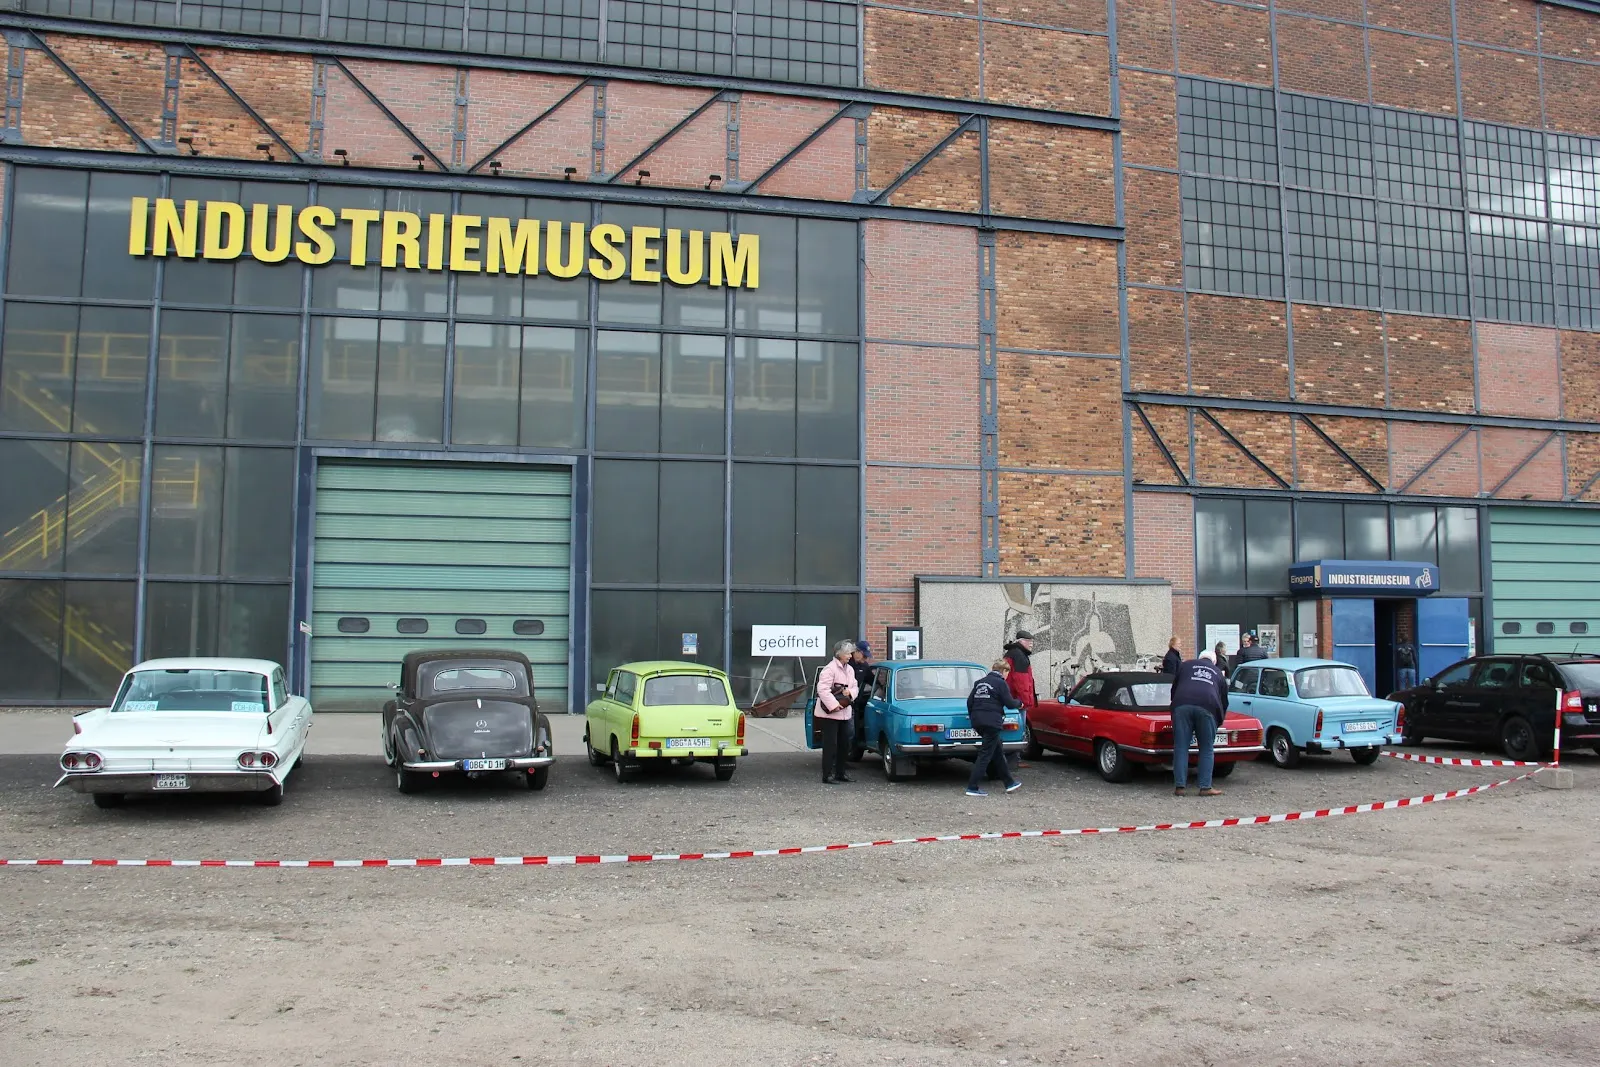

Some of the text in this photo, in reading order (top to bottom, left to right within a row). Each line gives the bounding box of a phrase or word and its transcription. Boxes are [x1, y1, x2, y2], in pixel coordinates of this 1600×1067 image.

[128, 196, 761, 290] INDUSTRIEMUSEUM
[1290, 575, 1314, 584] Eingang
[1328, 573, 1411, 586] INDUSTRIEMUSEUM
[759, 635, 819, 651] geöffnet
[950, 729, 964, 738] OBG
[967, 729, 972, 738] G
[670, 738, 684, 747] OBG
[469, 760, 484, 769] OBG
